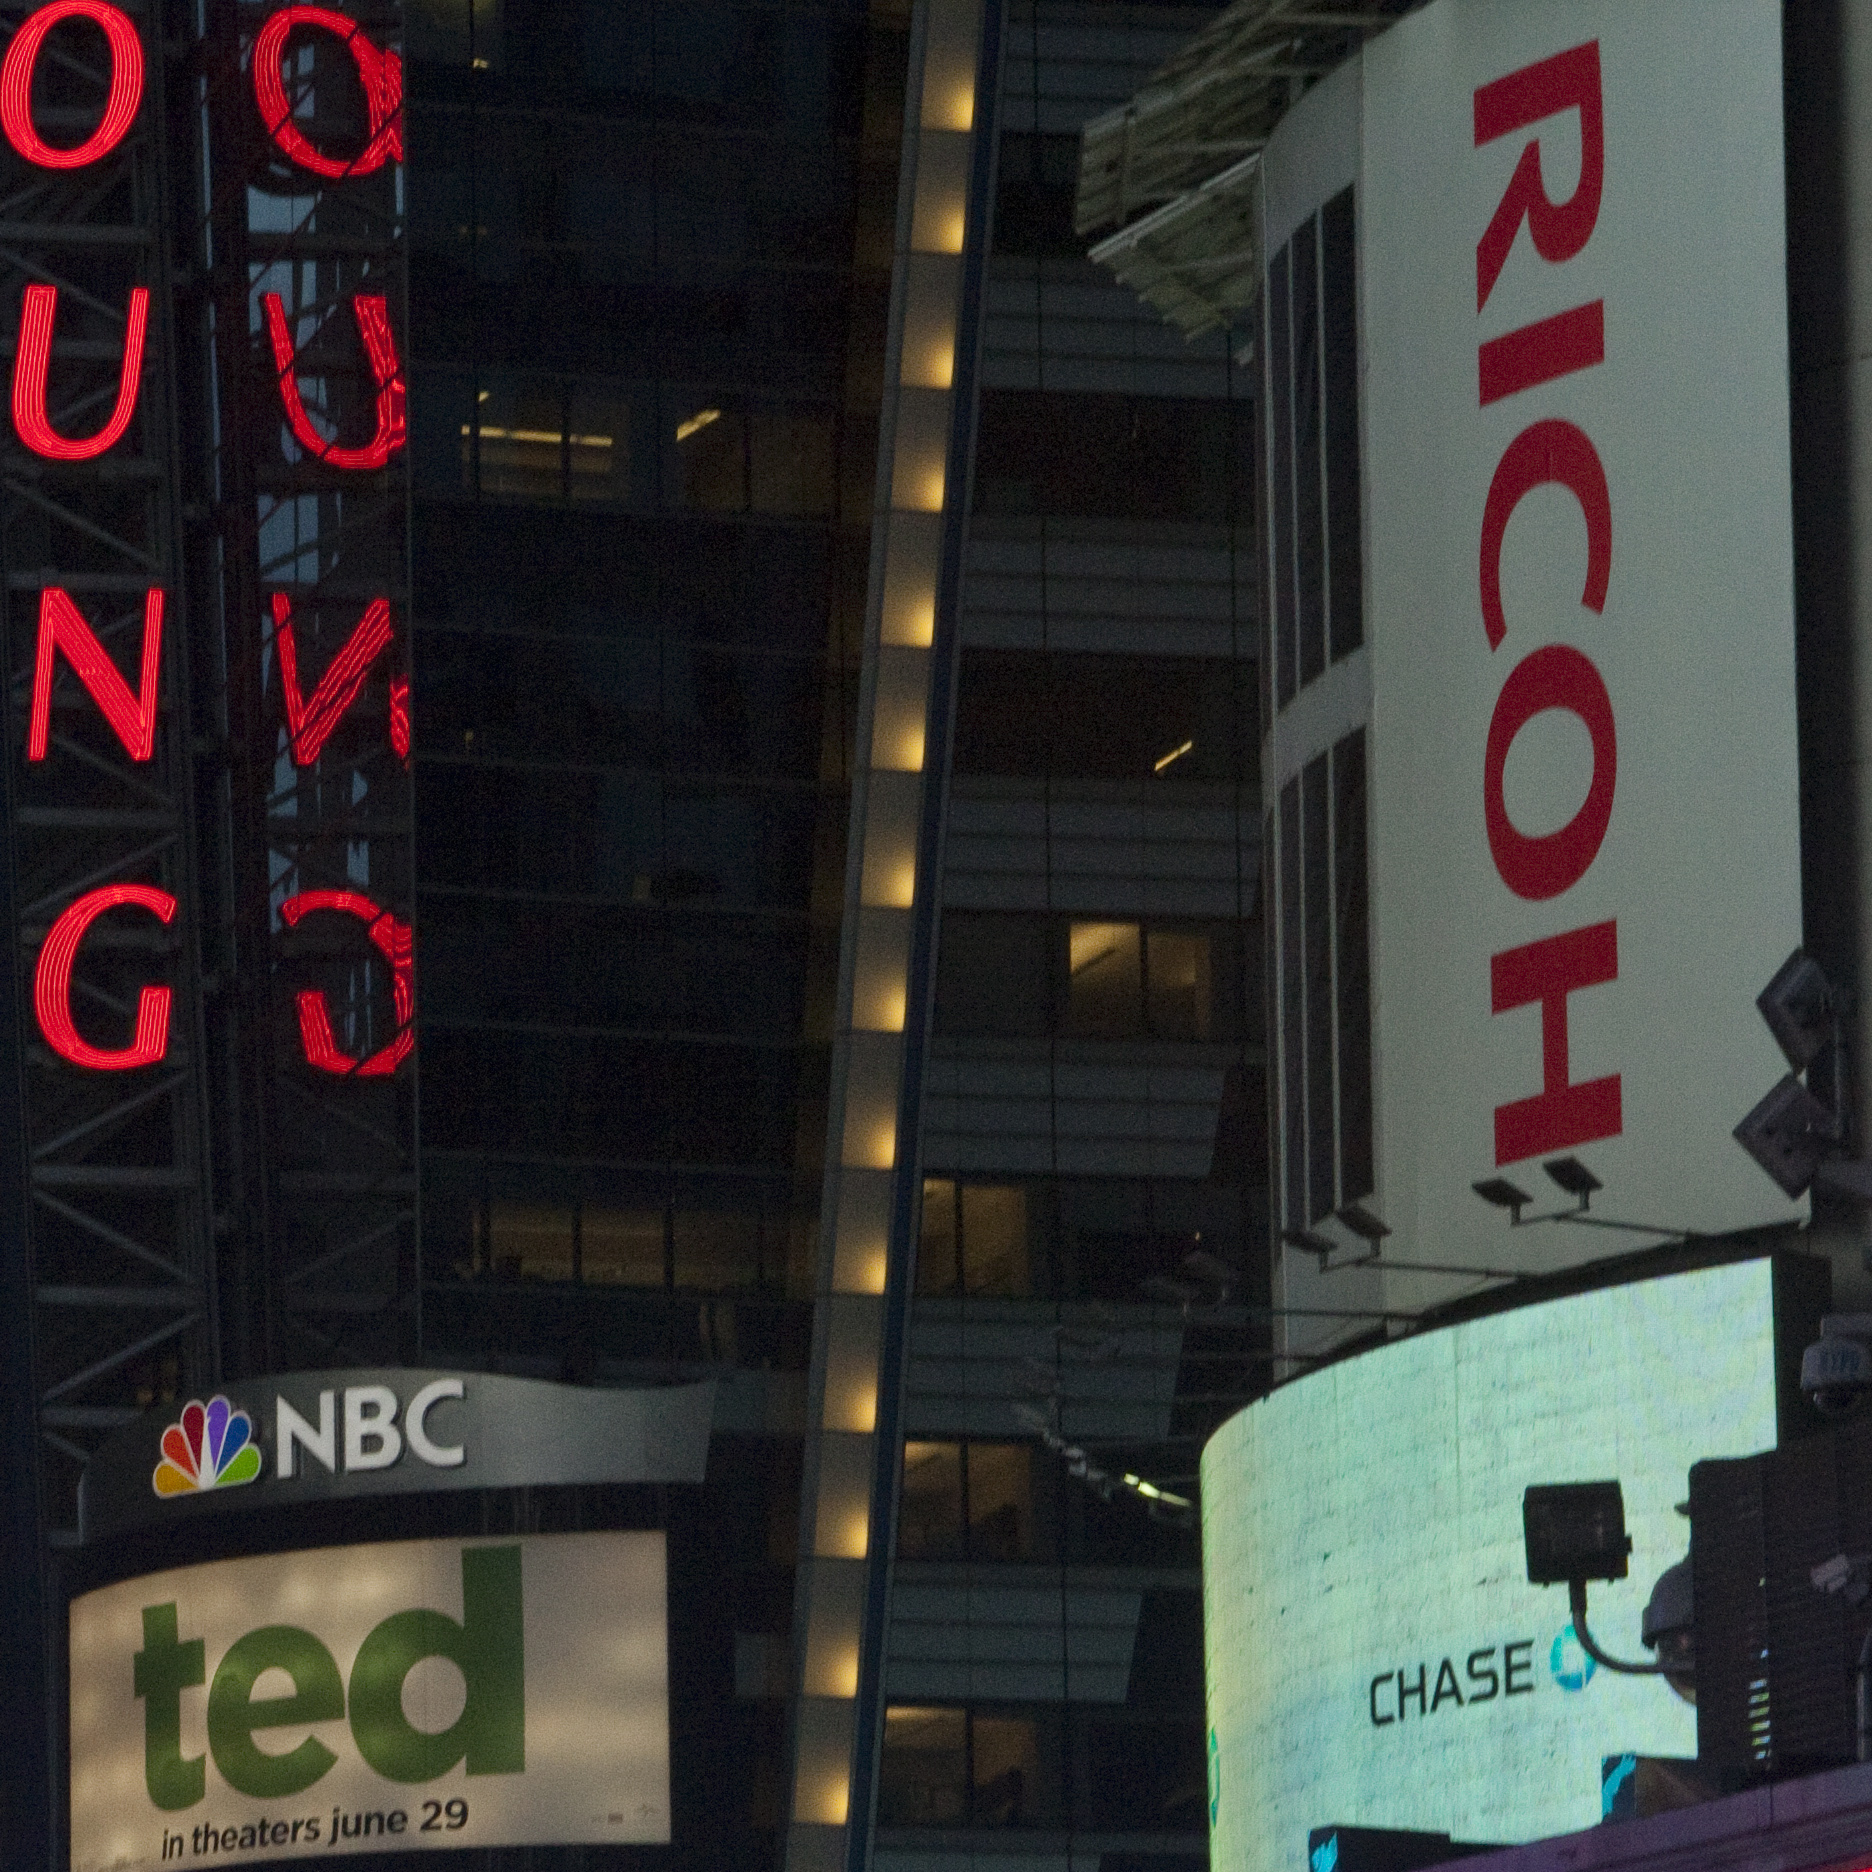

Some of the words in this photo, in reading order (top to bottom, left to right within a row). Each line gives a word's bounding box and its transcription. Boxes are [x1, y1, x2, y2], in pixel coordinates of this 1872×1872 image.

[1473, 38, 1623, 1168] RICOH
[276, 1379, 467, 1480] NBC
[133, 1544, 526, 1812] ted
[1369, 1638, 1535, 1729] CHASE
[162, 1829, 185, 1861] in
[192, 1815, 322, 1856] theaters
[327, 1806, 409, 1849] june
[419, 1798, 470, 1833] 29
